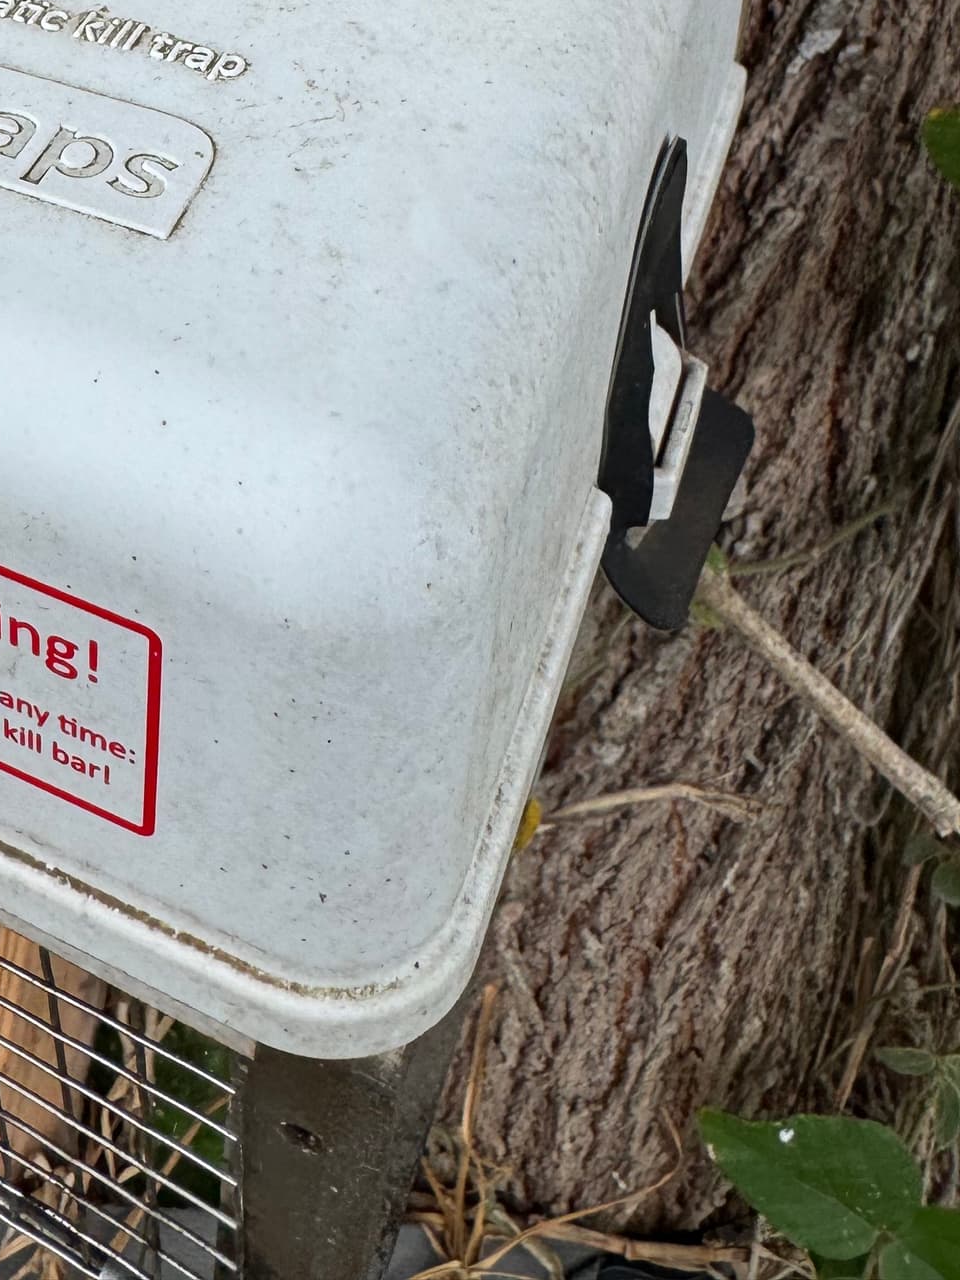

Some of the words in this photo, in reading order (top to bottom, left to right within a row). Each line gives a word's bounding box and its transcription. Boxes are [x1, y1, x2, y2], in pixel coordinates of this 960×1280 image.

[72, 9, 148, 51] kill
[149, 32, 249, 81] trap
[3, 718, 42, 754] kill
[52, 741, 111, 785] bar!
[57, 713, 137, 764] time:
